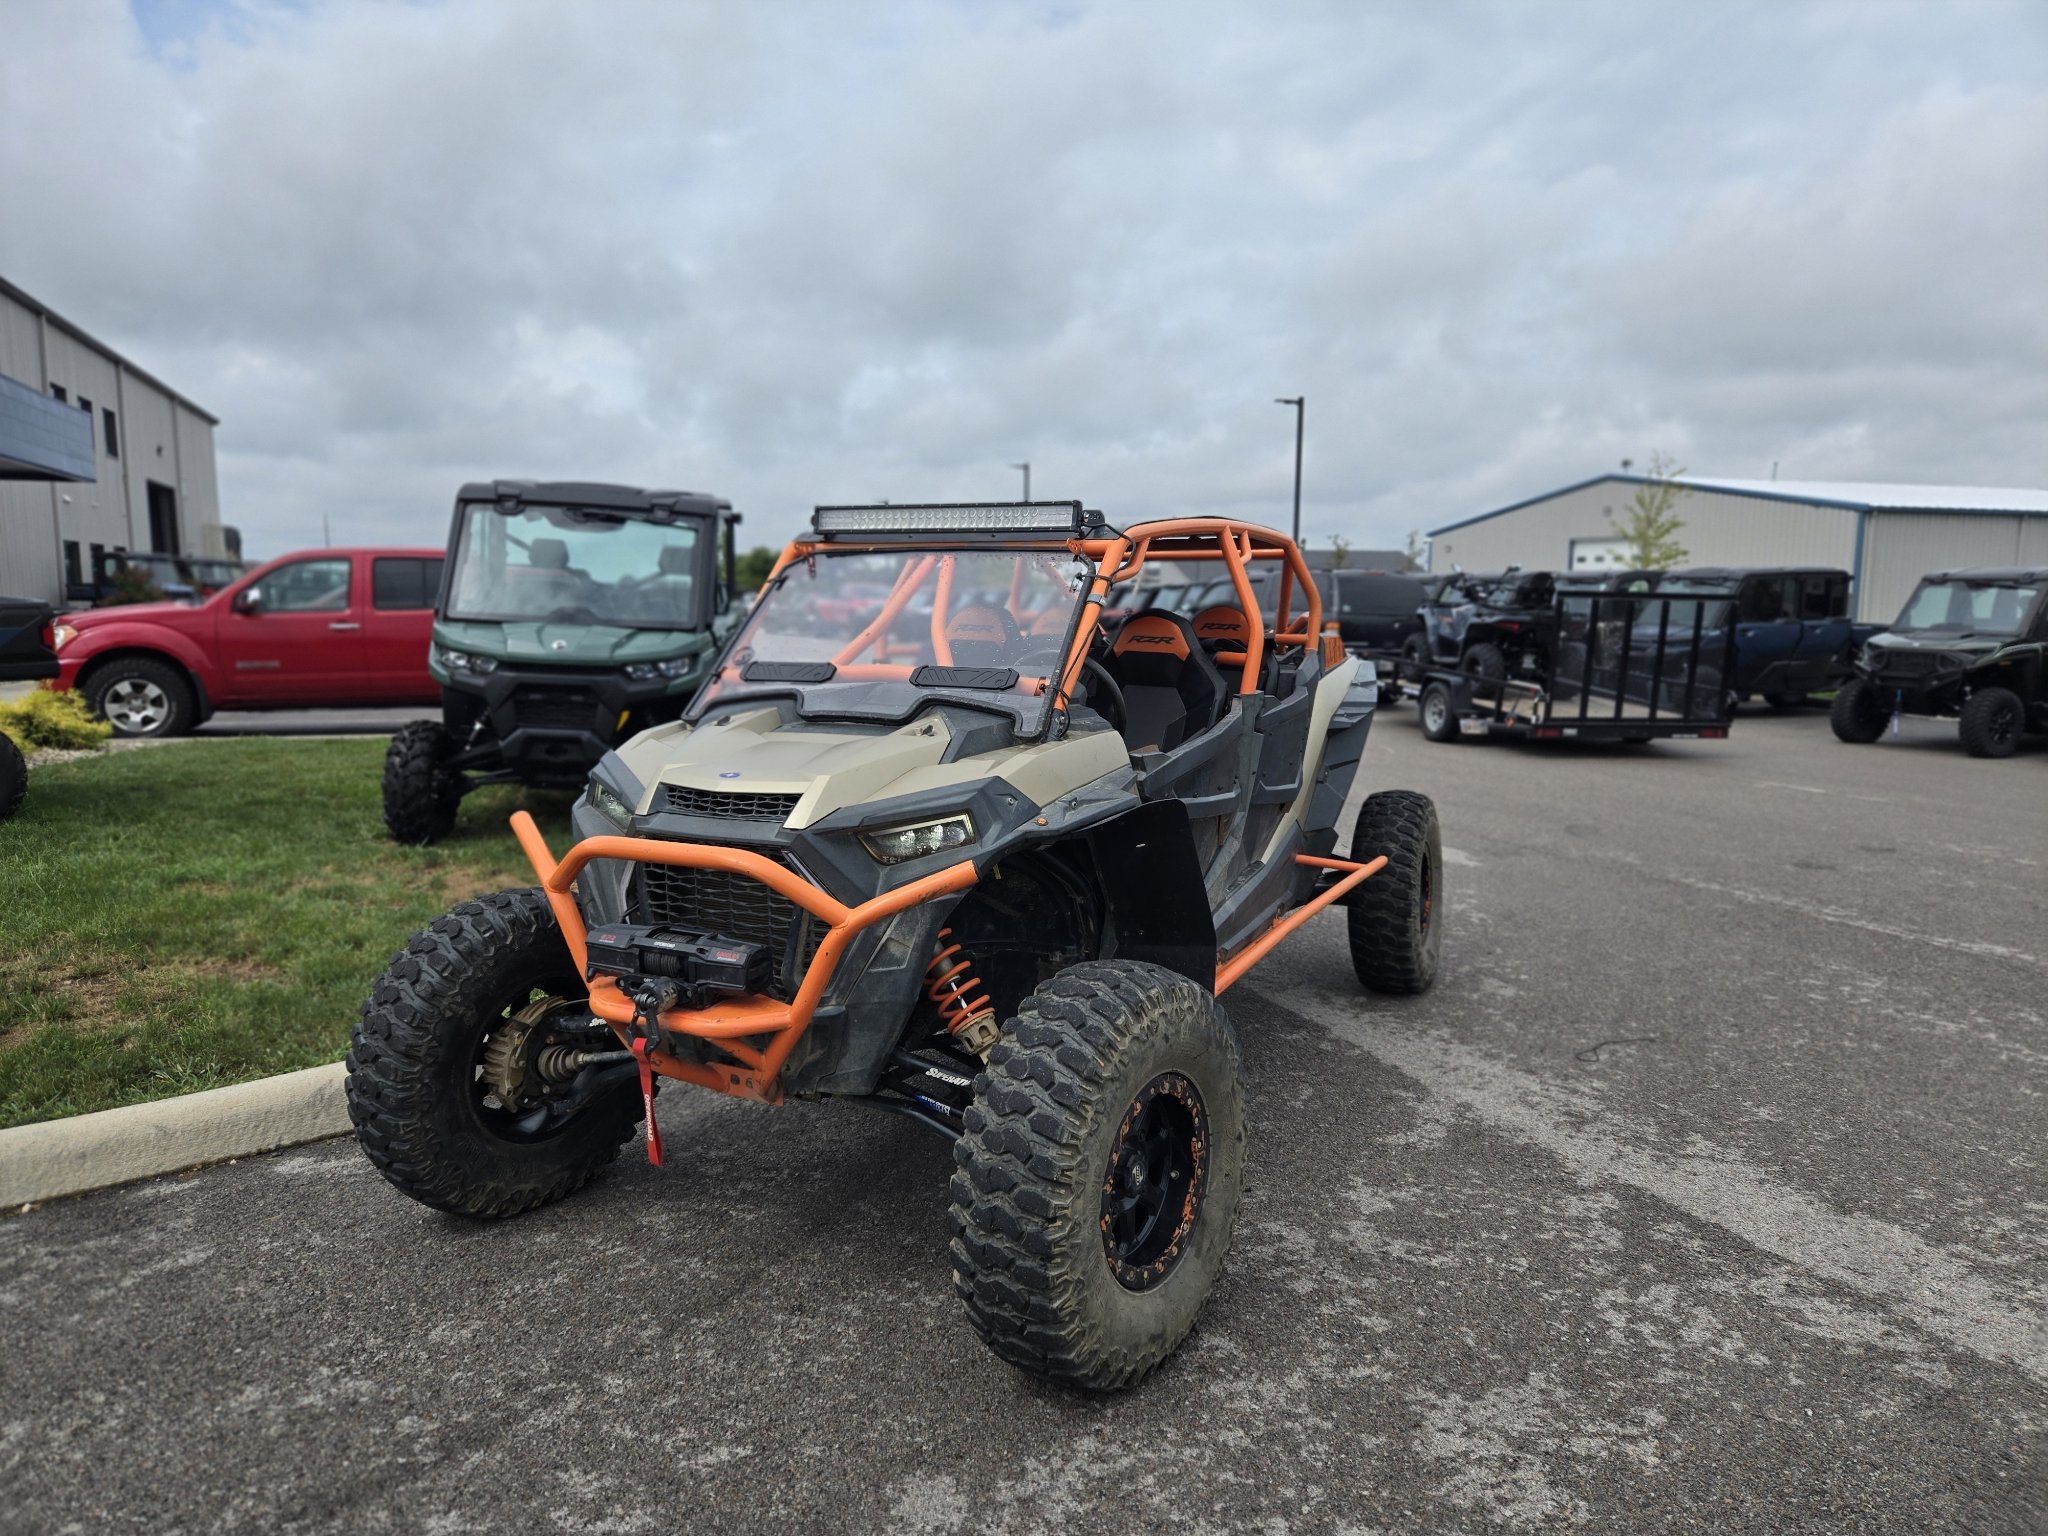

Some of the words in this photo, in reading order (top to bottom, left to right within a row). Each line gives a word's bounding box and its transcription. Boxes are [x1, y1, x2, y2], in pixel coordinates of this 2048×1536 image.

[1201, 623, 1241, 632] RZR
[1128, 635, 1175, 645] RZR
[644, 1094, 654, 1142] OPENROAD
